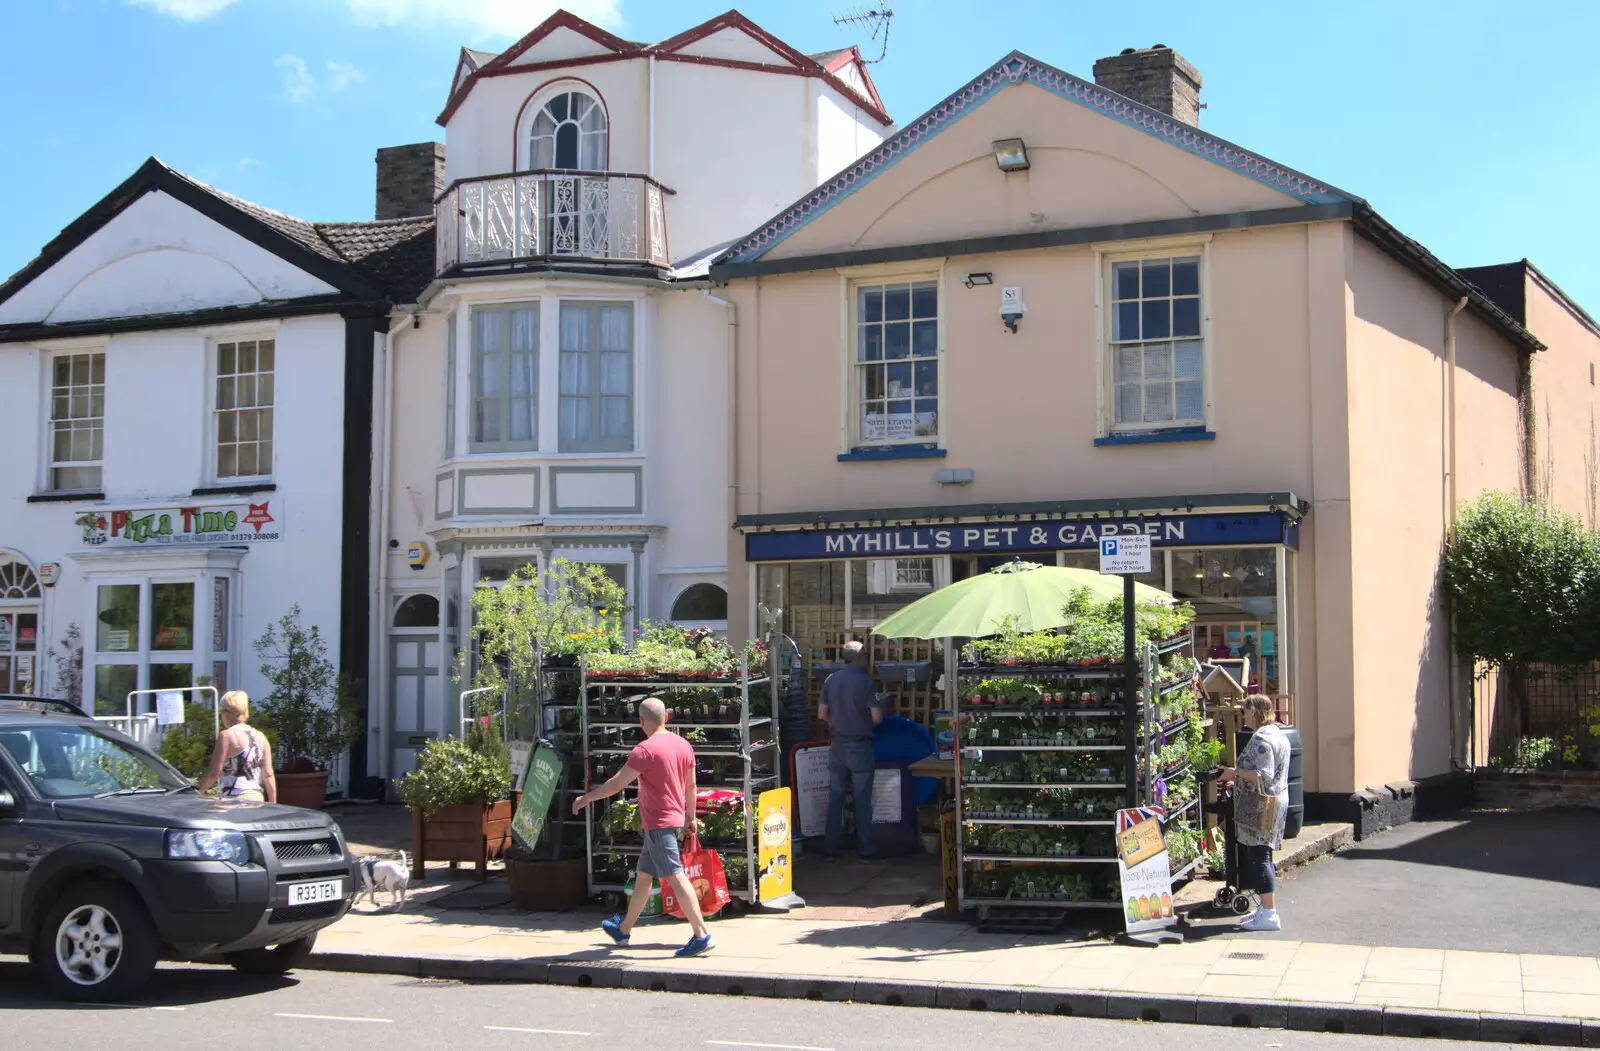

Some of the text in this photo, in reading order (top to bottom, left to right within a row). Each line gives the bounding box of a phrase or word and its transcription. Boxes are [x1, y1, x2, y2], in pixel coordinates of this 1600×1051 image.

[111, 507, 238, 543] Pizza Time
[83, 535, 108, 545] PIZZA
[230, 533, 252, 541] 01379
[825, 528, 952, 552] MYHILL'S
[963, 527, 1018, 548] PET
[1029, 526, 1048, 545] &
[1105, 541, 1115, 555] P
[763, 820, 786, 836] Symply
[1141, 866, 1168, 881] Natural
[297, 883, 336, 901] R33 TEN
